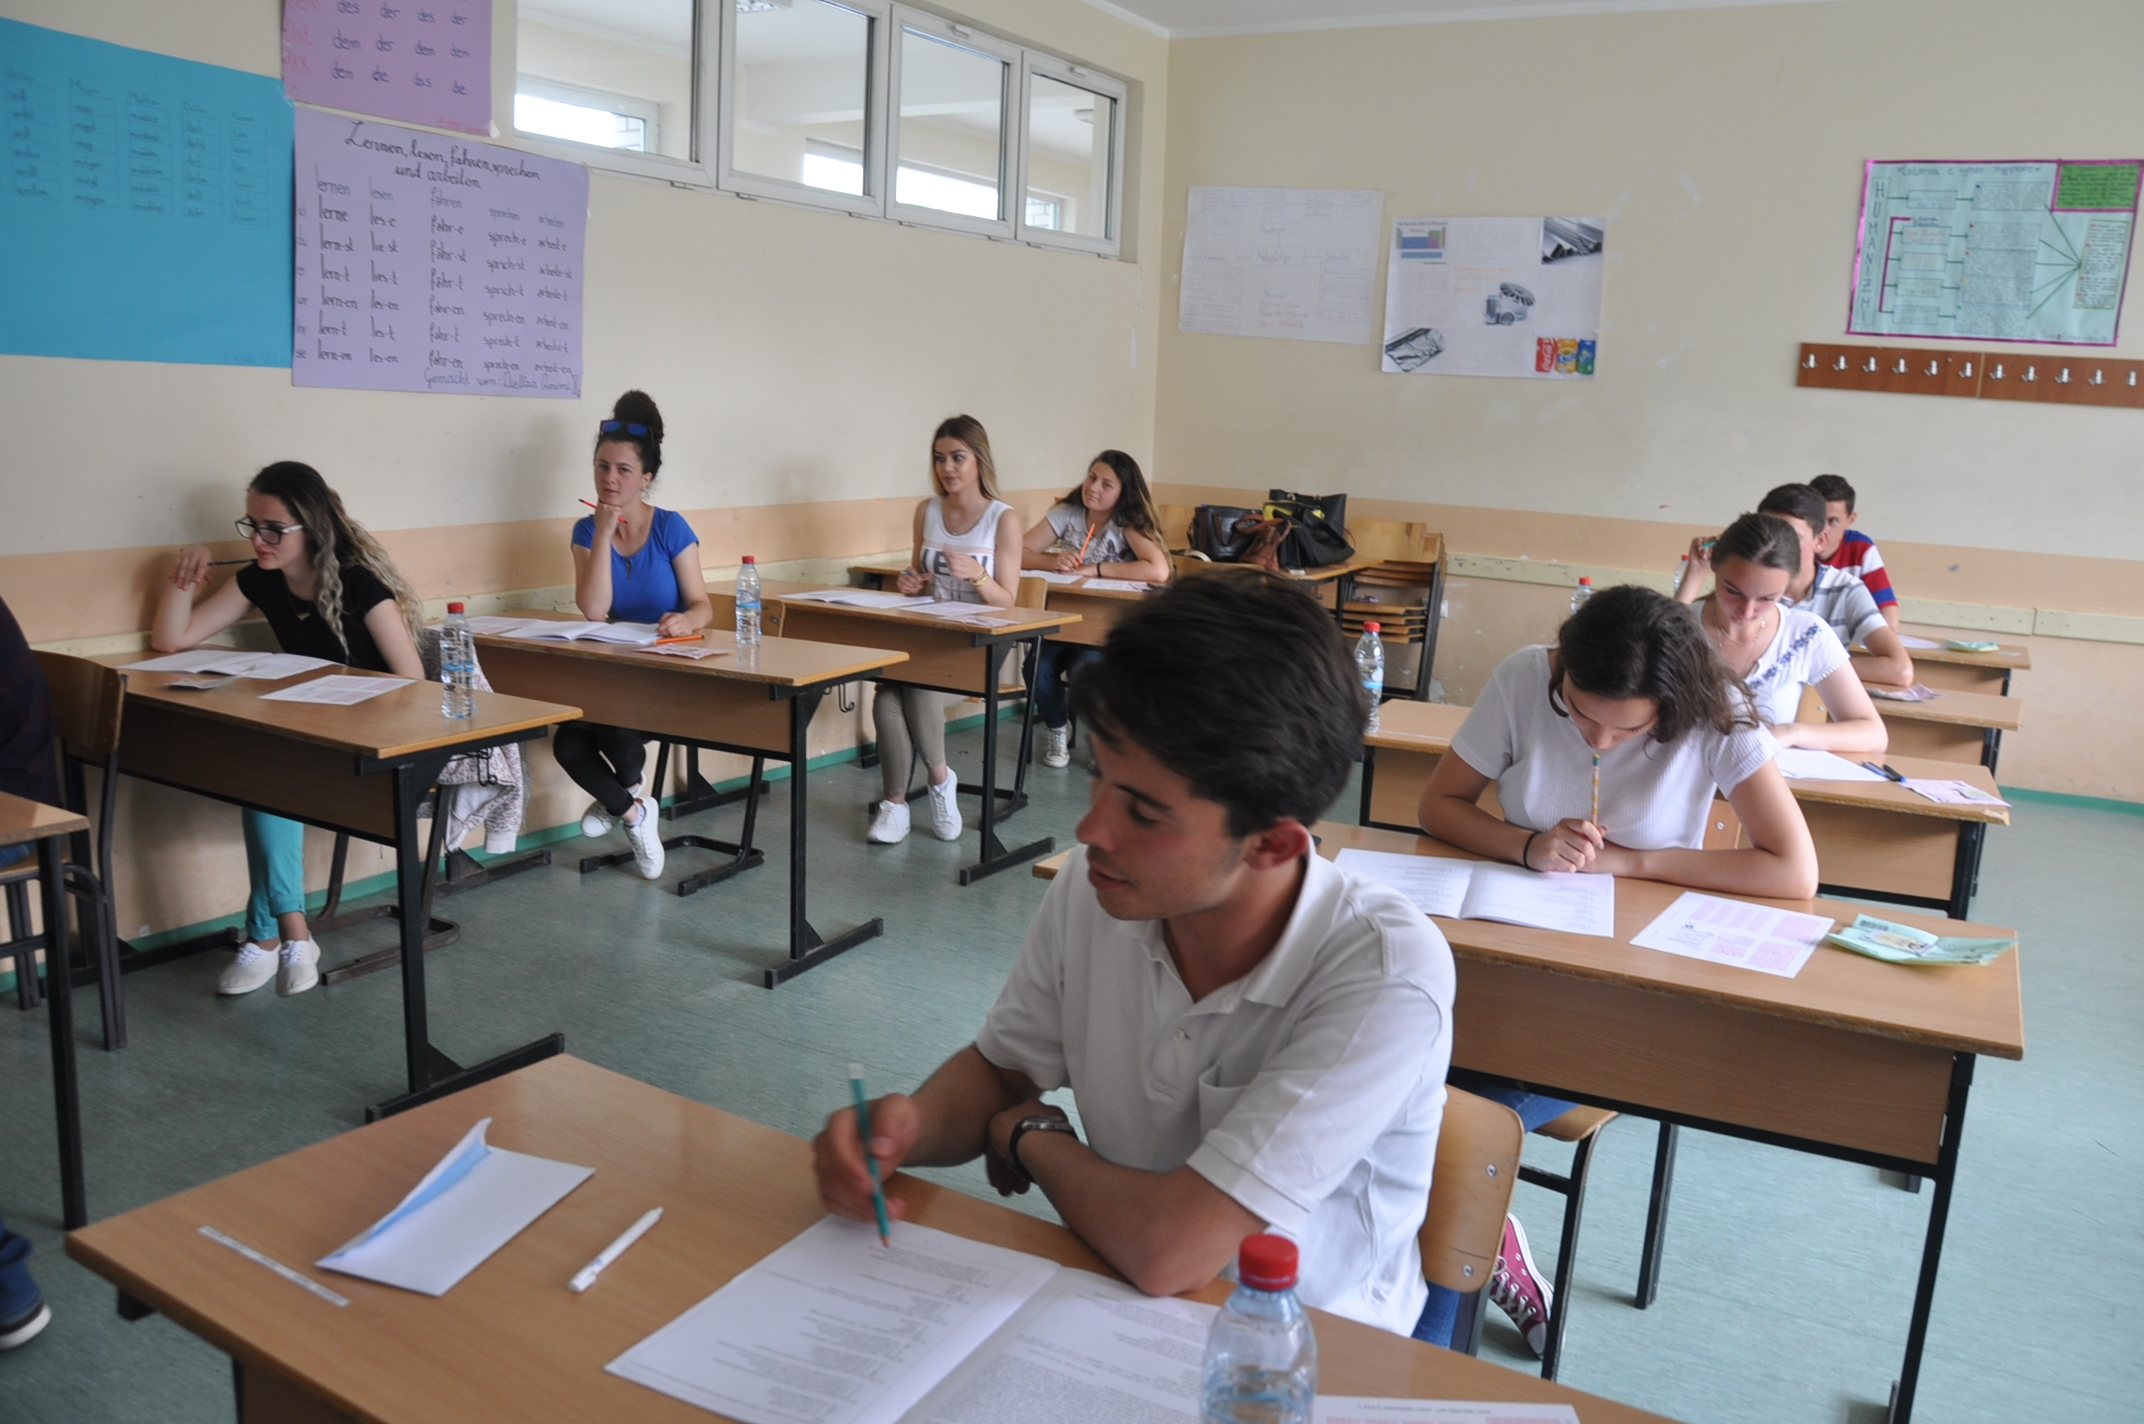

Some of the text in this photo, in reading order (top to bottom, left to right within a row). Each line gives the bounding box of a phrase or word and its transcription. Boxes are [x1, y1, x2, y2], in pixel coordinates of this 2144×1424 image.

[380, 1, 401, 20] der
[417, 6, 436, 24] des
[450, 9, 469, 26] der
[331, 28, 362, 50] dem
[375, 34, 395, 52] der
[331, 60, 355, 81] den
[413, 71, 433, 89] das
[314, 163, 351, 196] lernen
[395, 158, 482, 188] und arbeiten
[1861, 181, 1886, 322] HUMANIZMI
